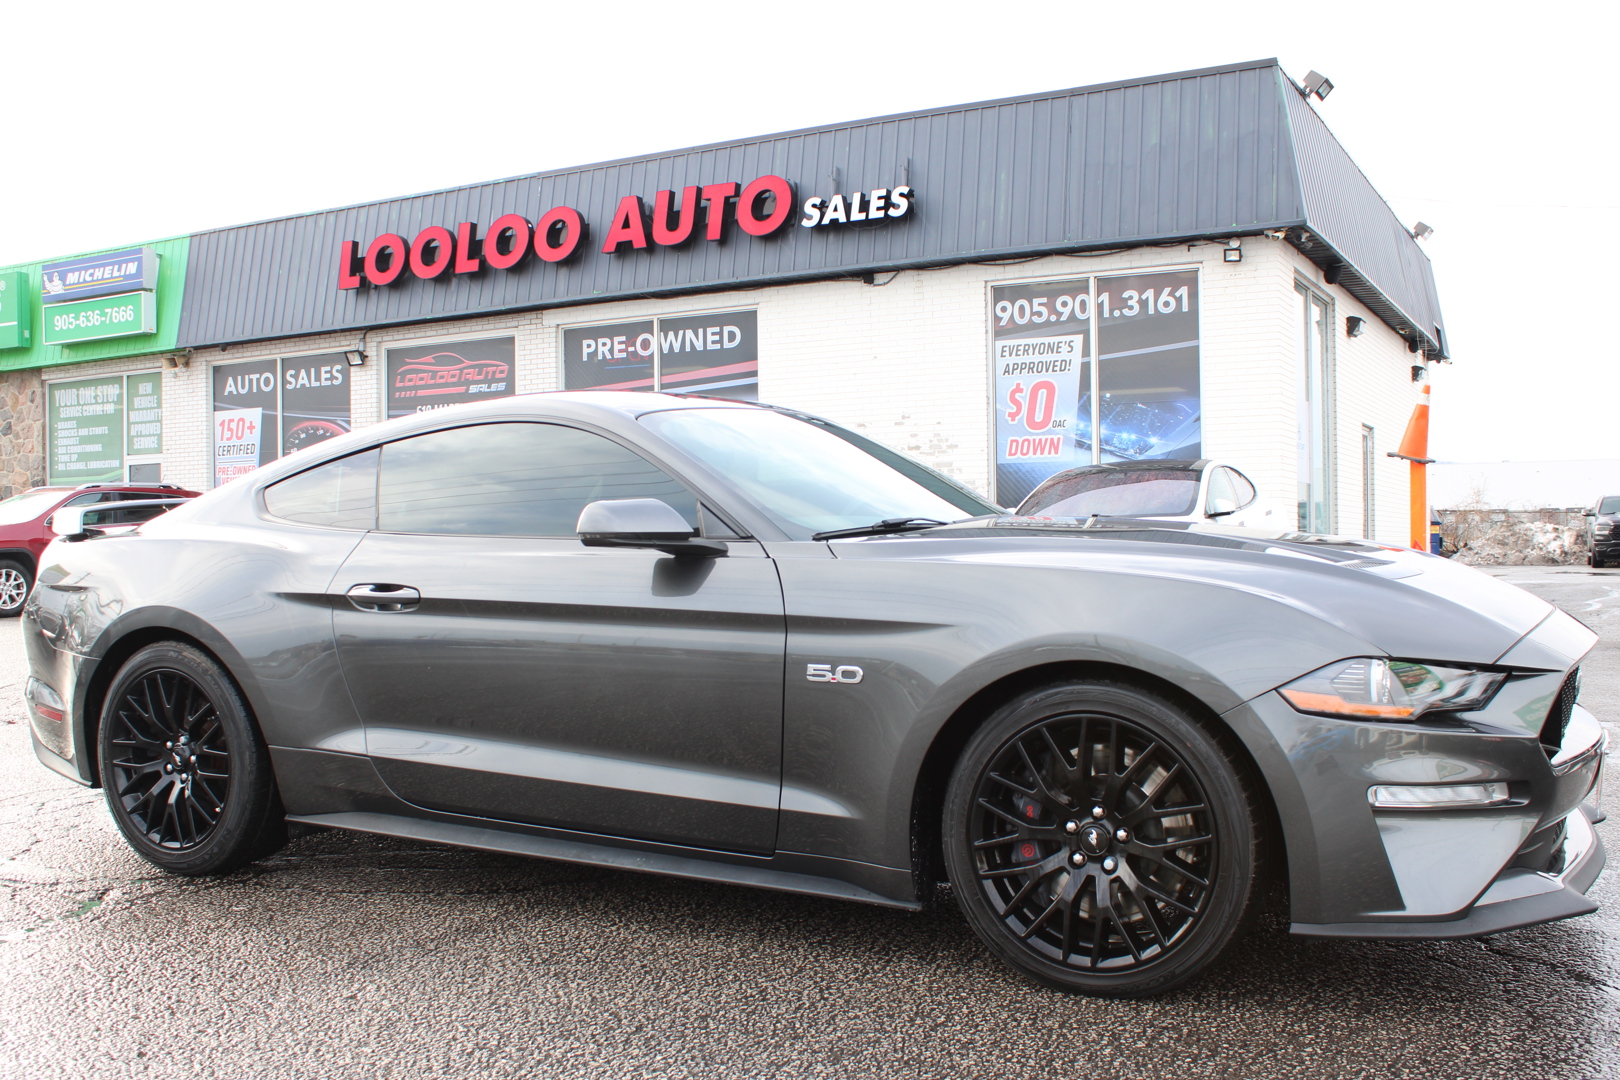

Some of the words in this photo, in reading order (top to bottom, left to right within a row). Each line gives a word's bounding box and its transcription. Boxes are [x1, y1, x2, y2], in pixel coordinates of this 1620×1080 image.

[339, 206, 583, 290] LOOLOO
[601, 175, 794, 254] AUTO
[801, 186, 912, 228] SALES
[66, 262, 138, 285] MICHELIN
[995, 286, 1189, 326] 905.901.3161
[54, 305, 134, 331] 905-636-7666
[582, 325, 742, 361] PRE-OWNED
[1000, 340, 1074, 358] EVERYONE'S
[395, 370, 460, 387] LOOLOO
[461, 366, 509, 381] AUTO
[1002, 359, 1072, 376] APPROVED!
[138, 382, 153, 395] NEW
[224, 372, 274, 395] AUTO
[285, 365, 343, 390] SALES
[468, 382, 507, 393] SALES
[55, 388, 77, 406] YOUR
[79, 386, 96, 404] ONE
[97, 384, 120, 403] STOP
[133, 395, 157, 409] VEHICLE
[59, 406, 82, 418] SERVICE
[103, 403, 114, 414] FOR
[1007, 380, 1056, 431] $0
[1052, 419, 1066, 429] OAC
[129, 409, 162, 423] WARRANTY
[78, 428, 88, 436] AND
[89, 426, 108, 435] STRUTS
[130, 422, 161, 436] APPROVED
[218, 417, 256, 442] 150+
[133, 436, 158, 449] SERVICE
[217, 443, 256, 457] CERTIFIED
[1007, 437, 1061, 457] DOWN
[58, 462, 66, 470] OIL
[806, 664, 863, 684] 5.0
